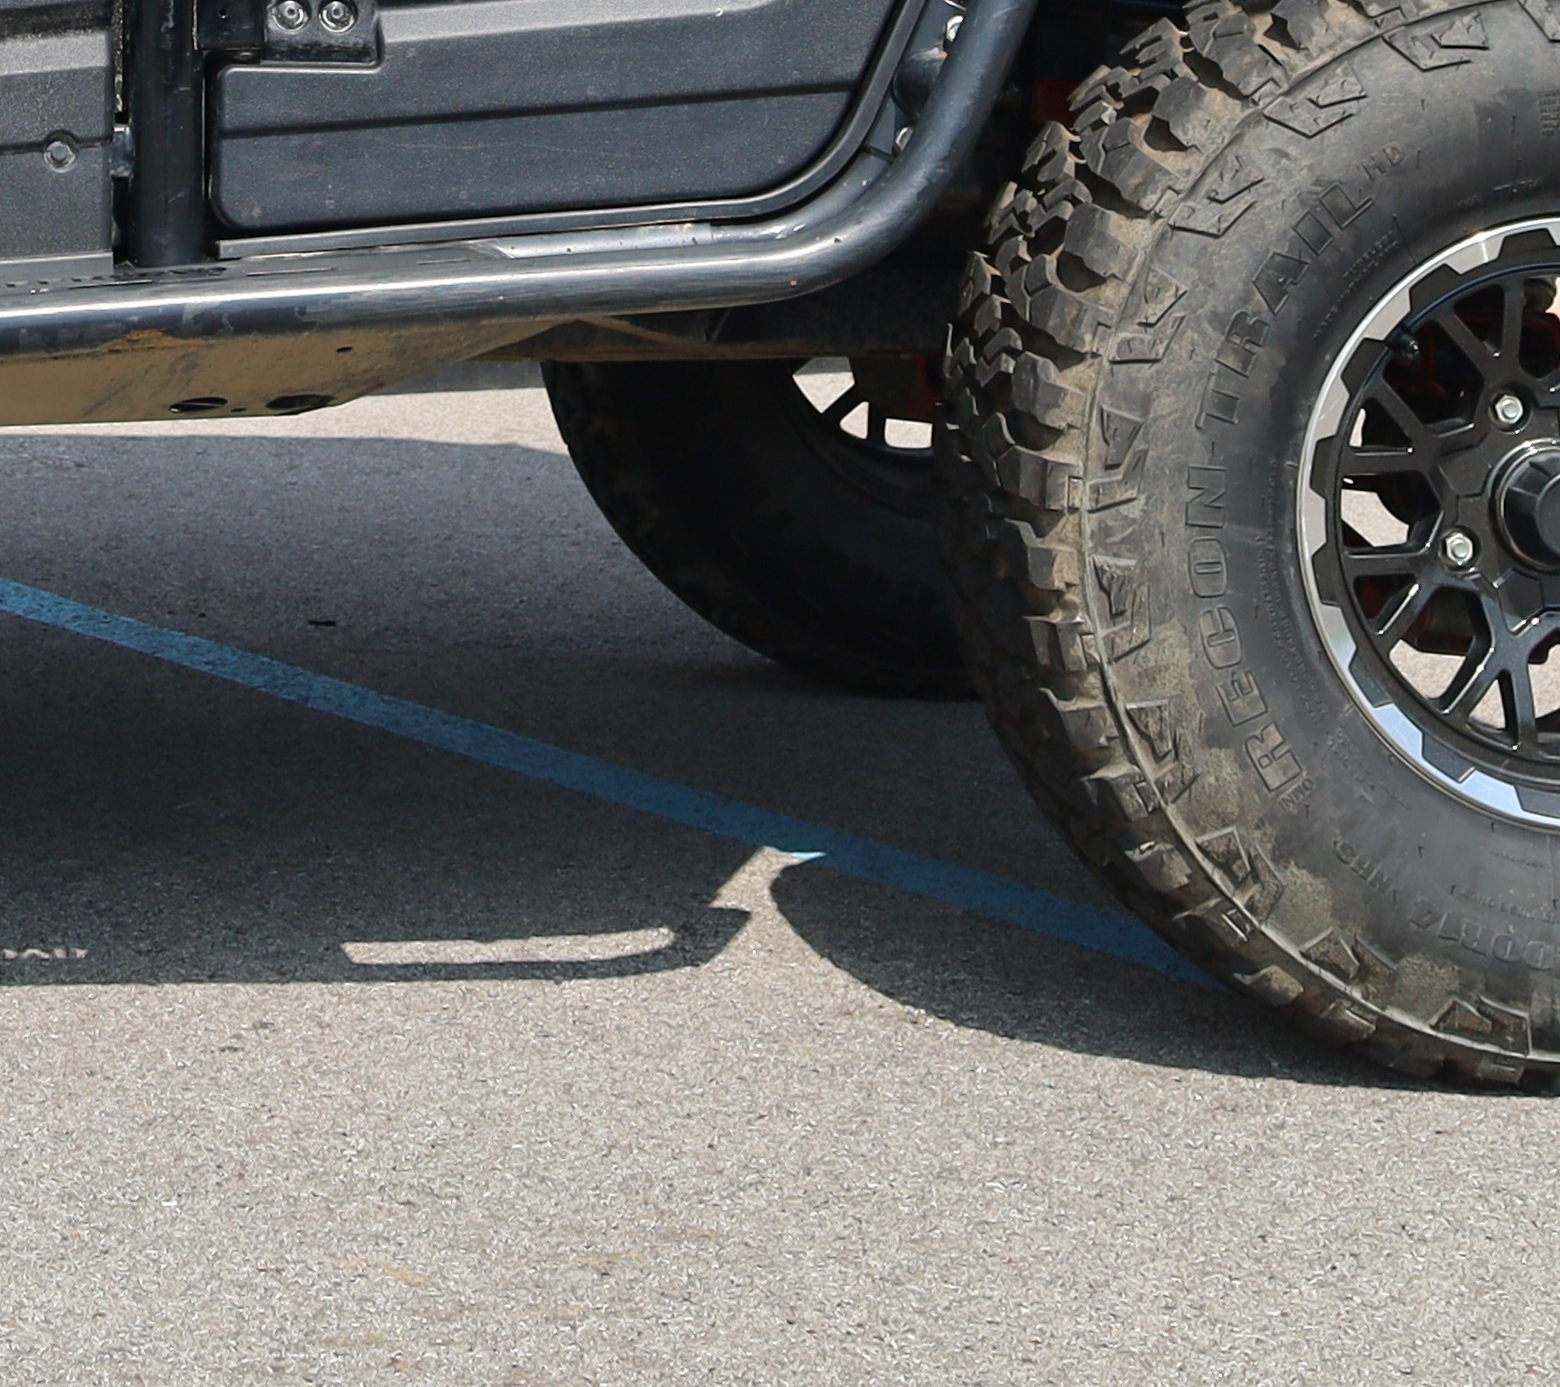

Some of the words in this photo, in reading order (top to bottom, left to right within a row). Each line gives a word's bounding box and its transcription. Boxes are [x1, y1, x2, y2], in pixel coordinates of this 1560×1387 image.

[1359, 141, 1406, 183] HD
[1195, 177, 1377, 433] TRAIL
[1184, 460, 1309, 795] RECON
